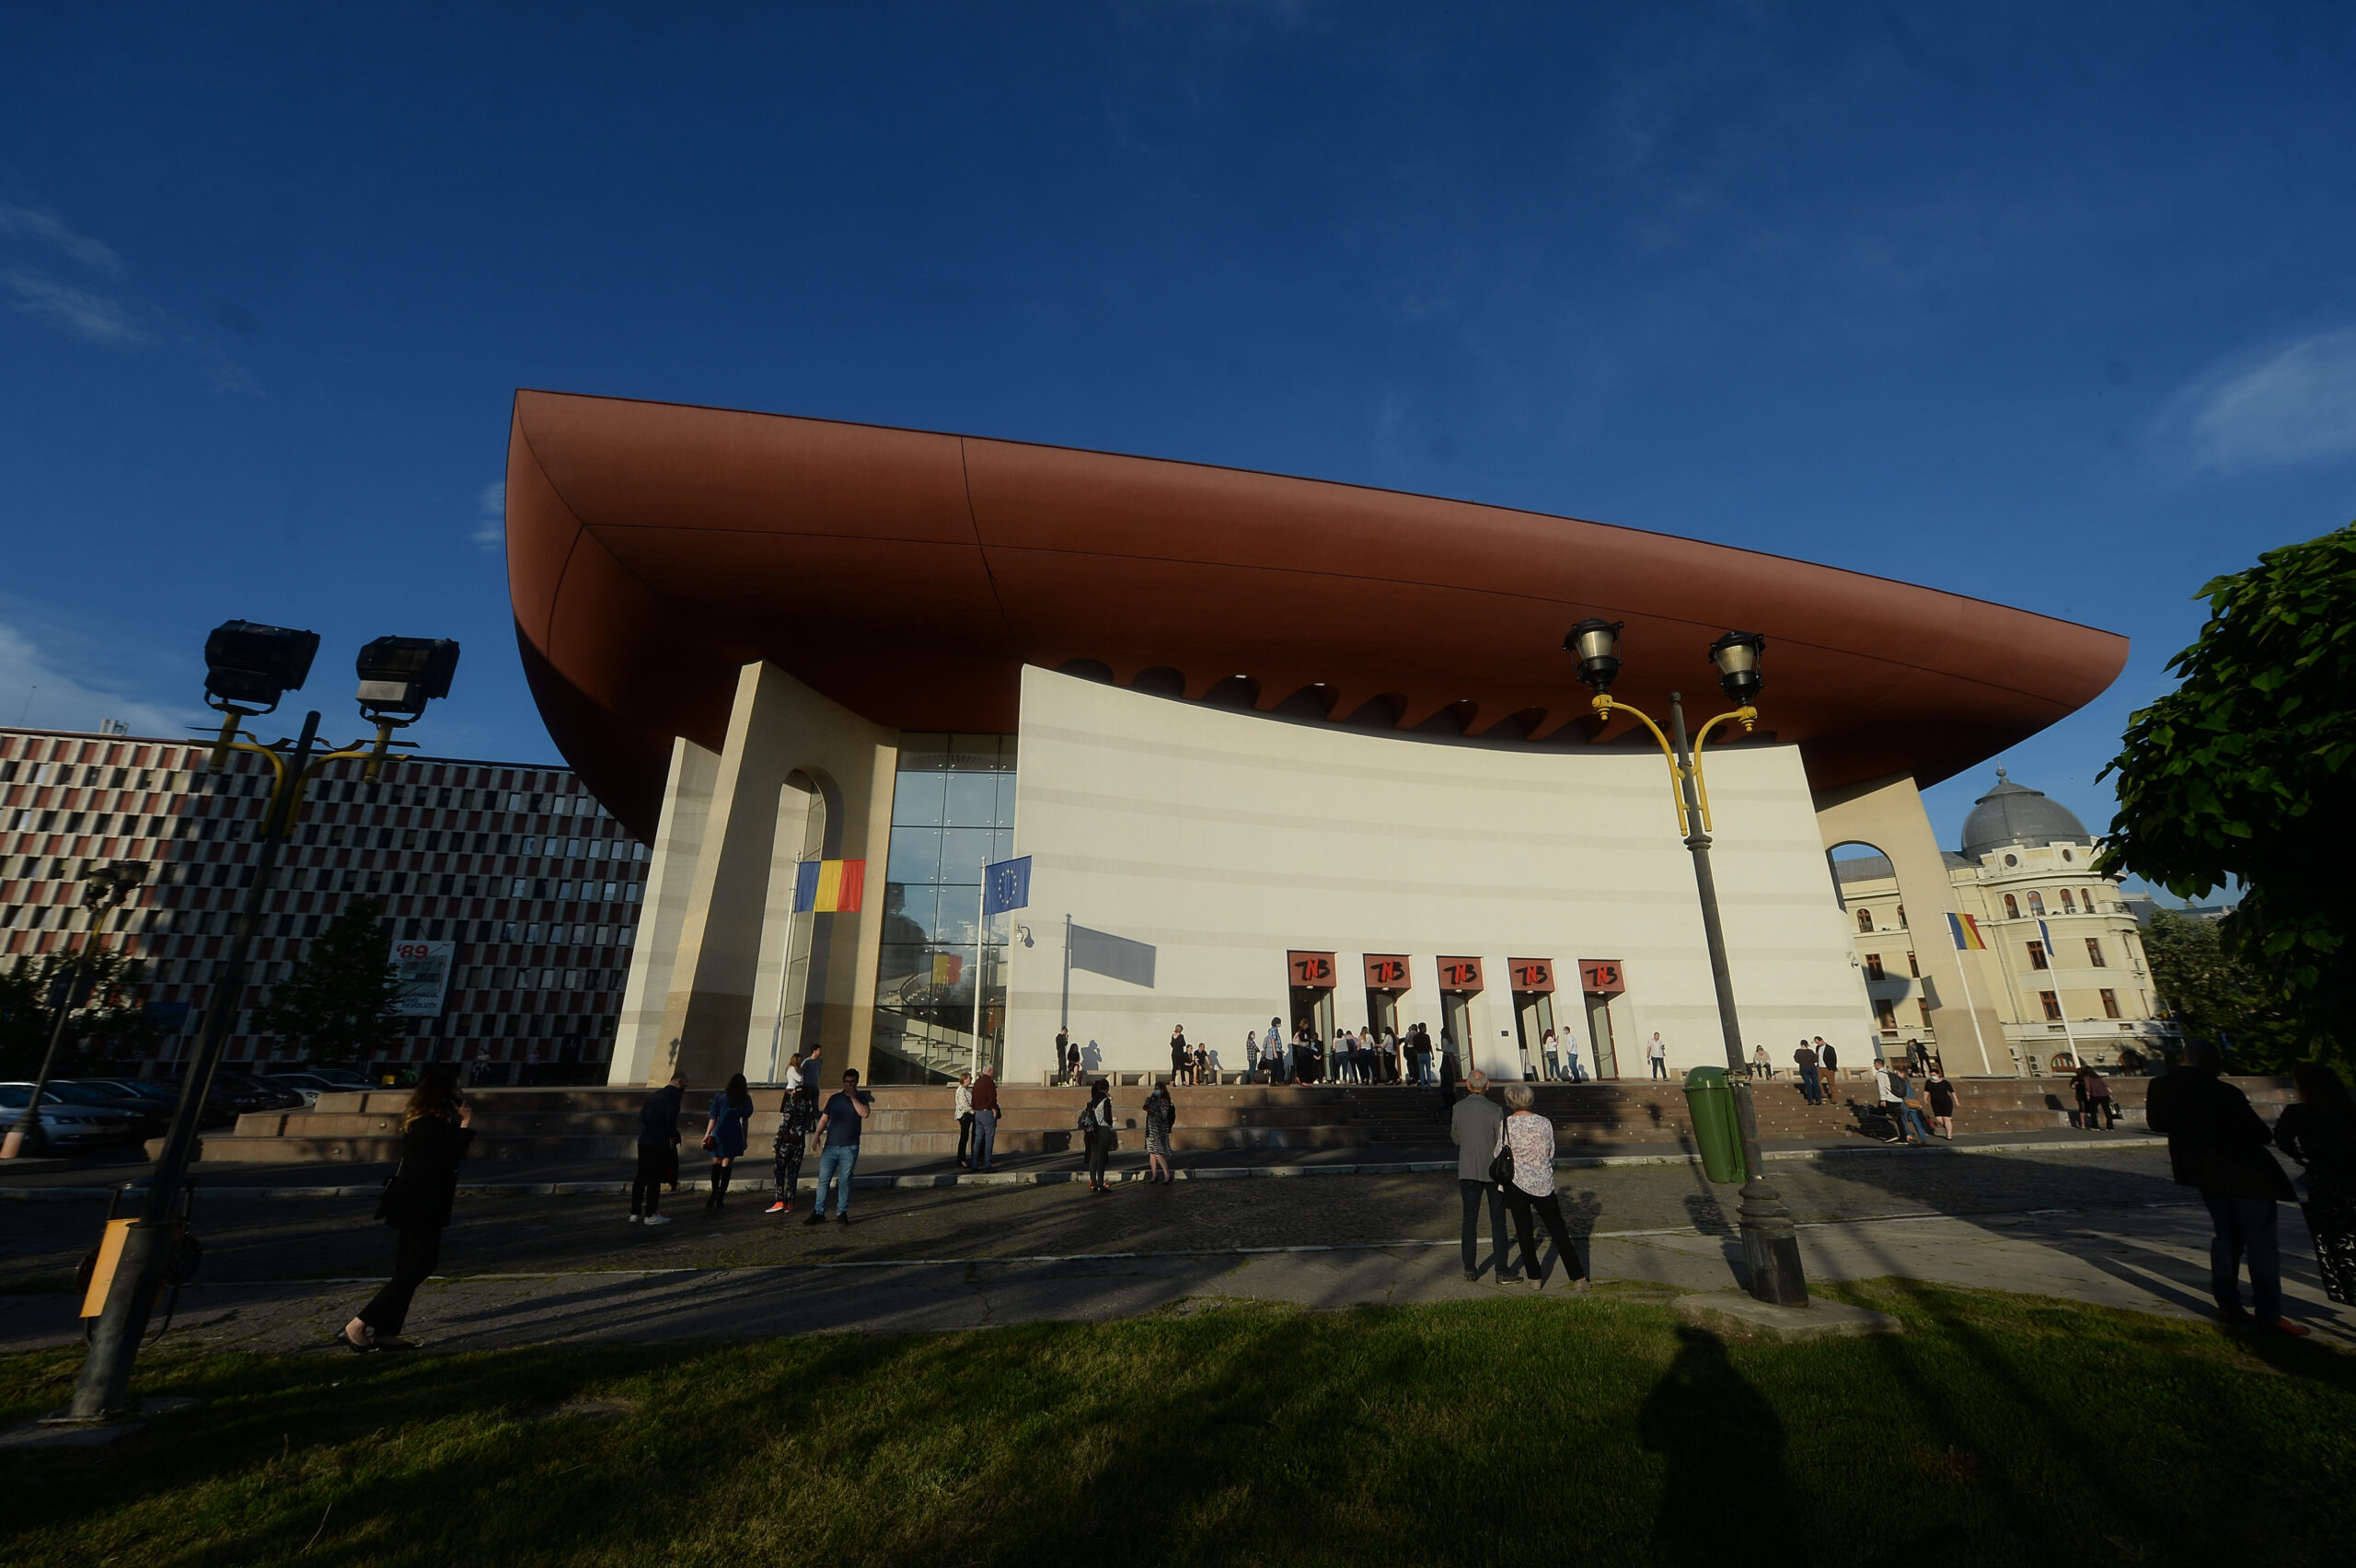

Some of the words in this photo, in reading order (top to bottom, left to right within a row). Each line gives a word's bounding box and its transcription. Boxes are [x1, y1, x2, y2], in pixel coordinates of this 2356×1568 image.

[1295, 958, 1332, 981] TNB
[1370, 961, 1405, 983] TNB
[1443, 963, 1477, 985] TNB
[1515, 964, 1548, 986] TNB
[1586, 965, 1618, 986] TNB
